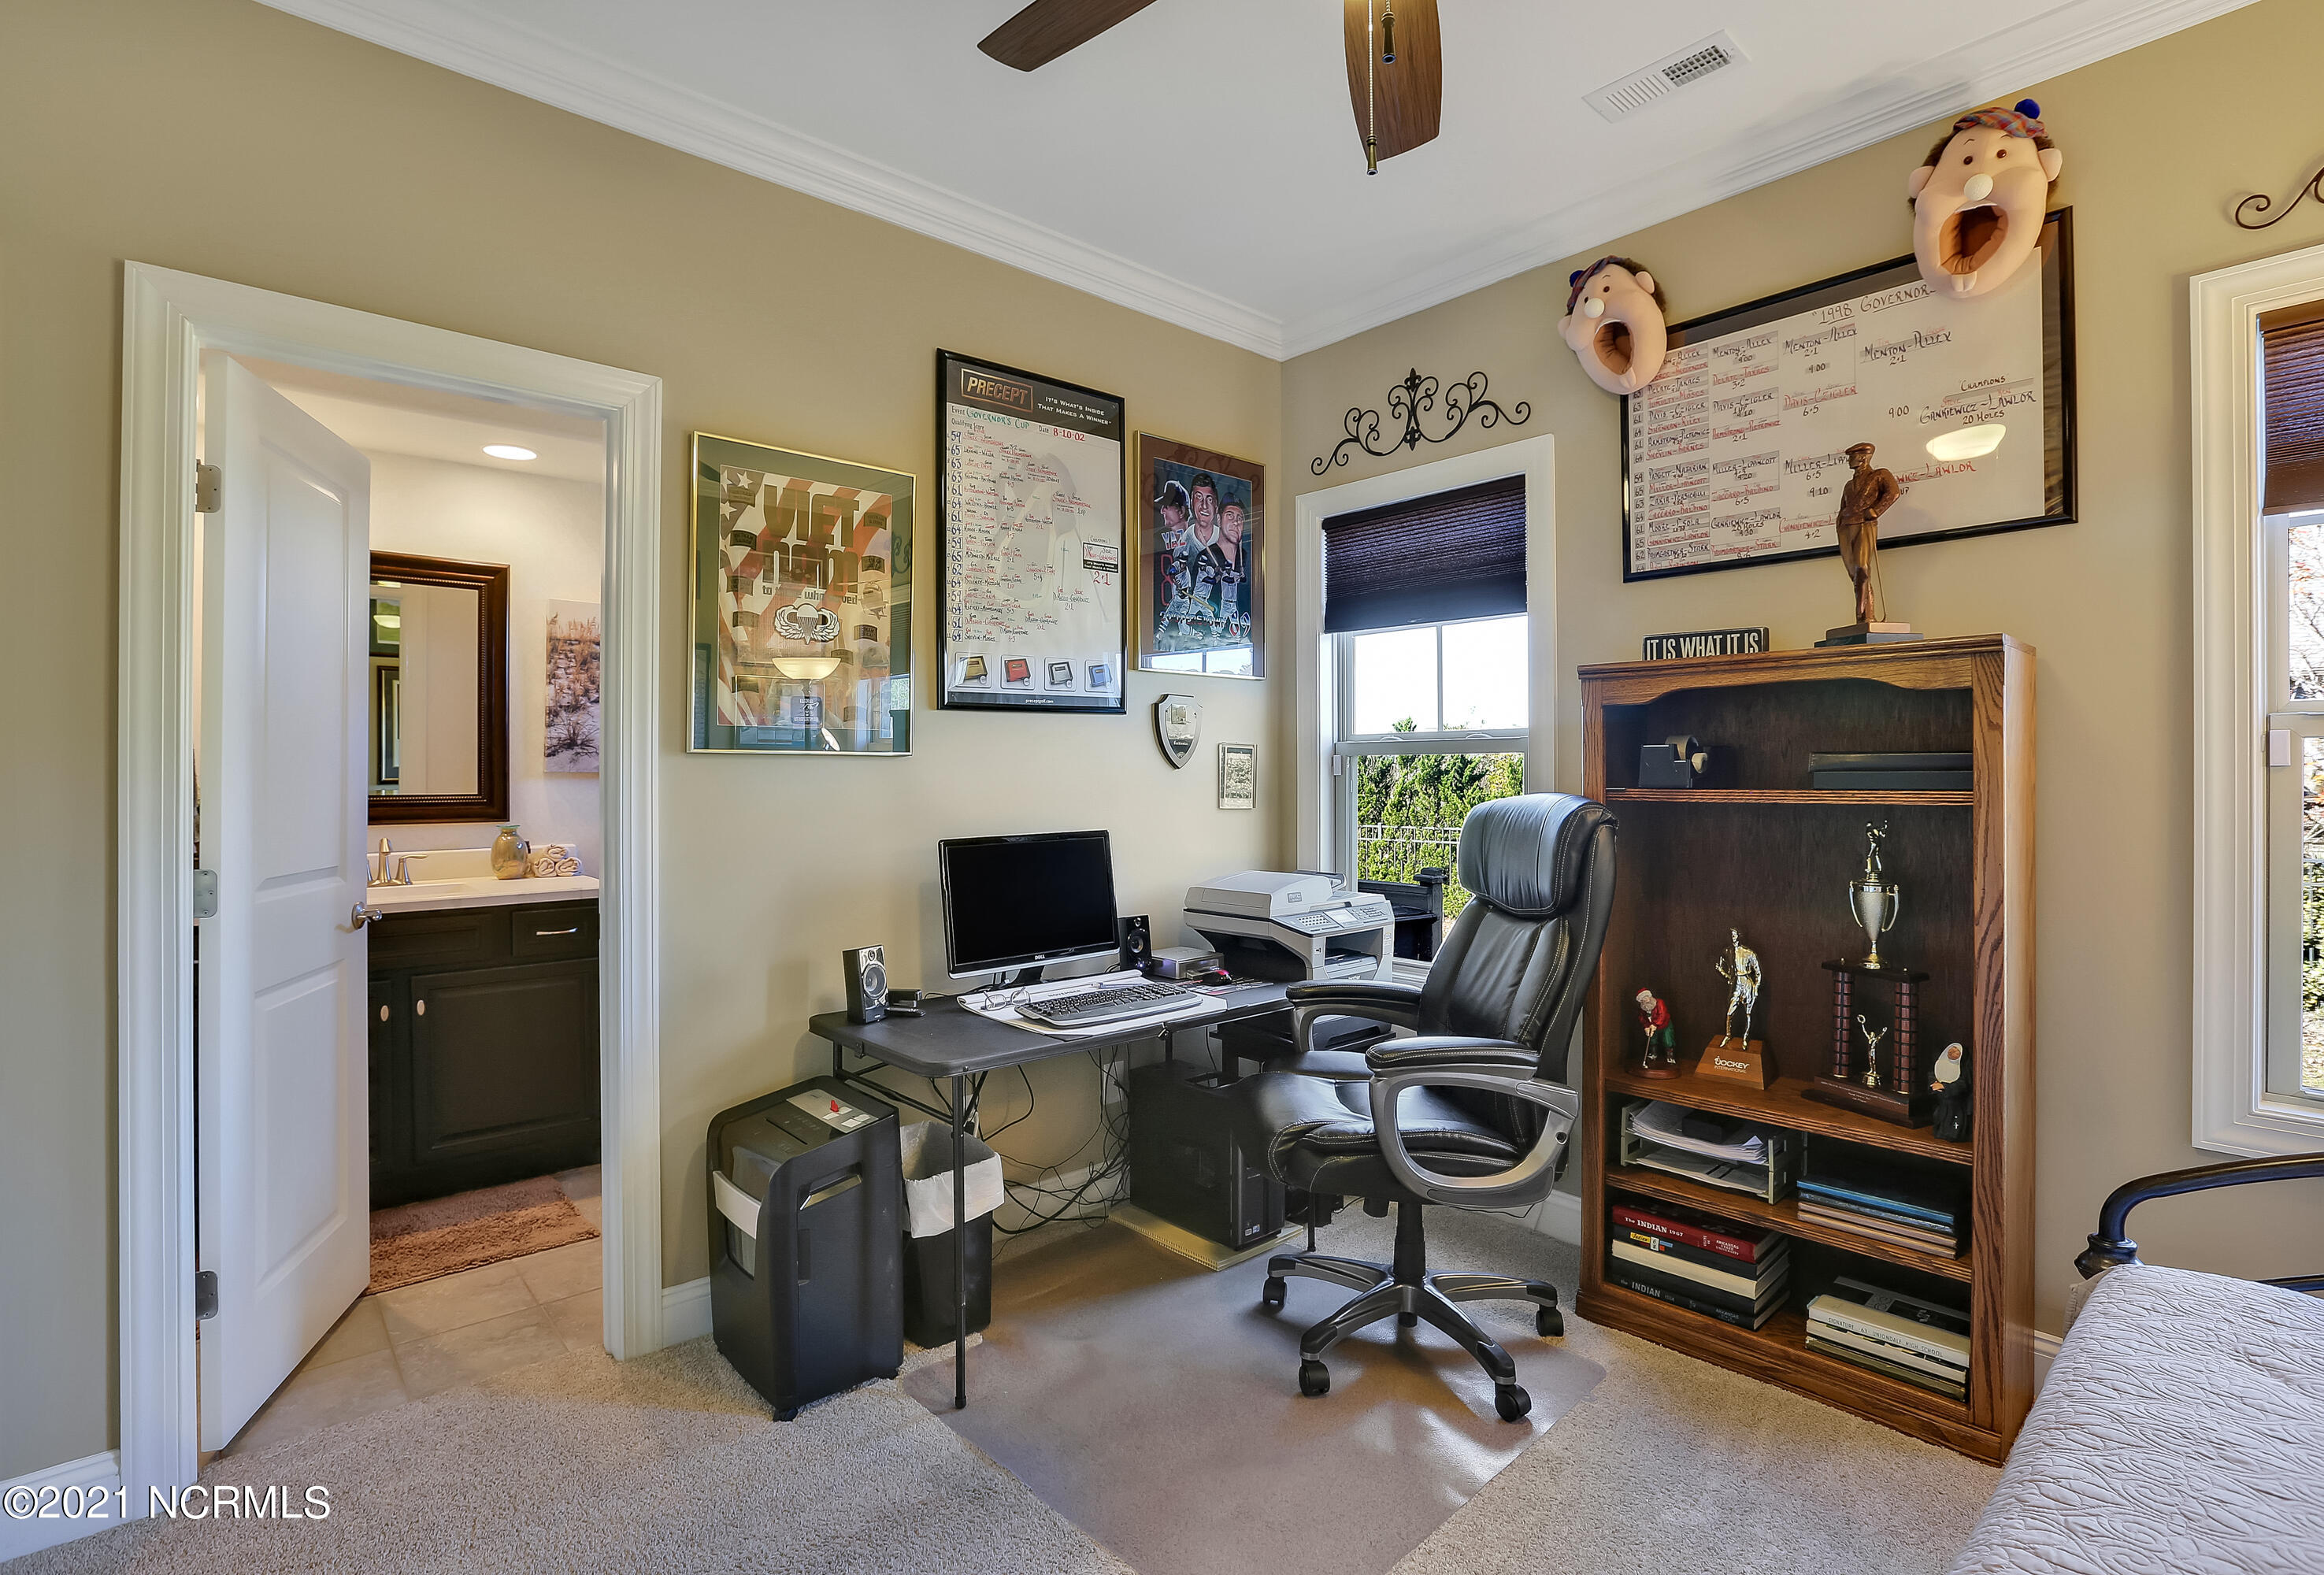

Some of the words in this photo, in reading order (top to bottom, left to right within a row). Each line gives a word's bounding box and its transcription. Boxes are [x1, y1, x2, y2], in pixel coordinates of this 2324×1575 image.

[966, 377, 1028, 404] PRECEPT
[951, 406, 966, 416] Event
[1056, 408, 1077, 417] MAKES
[1015, 420, 1029, 429] CUP
[1647, 639, 1659, 661] IT
[1662, 638, 1676, 659] IS
[1680, 635, 1722, 658] WHAT
[1727, 633, 1740, 654] IT
[1744, 632, 1759, 653] IS
[1714, 1056, 1749, 1069] JOCKEY
[1637, 1220, 1667, 1233] INDIAN
[1632, 1281, 1661, 1298] INDIAN
[1829, 1317, 1854, 1330] SIGNATURE
[1873, 1332, 1902, 1344] UNIONDALE
[1906, 1341, 1918, 1350] HIGH
[1921, 1346, 1943, 1358] SCHOOL
